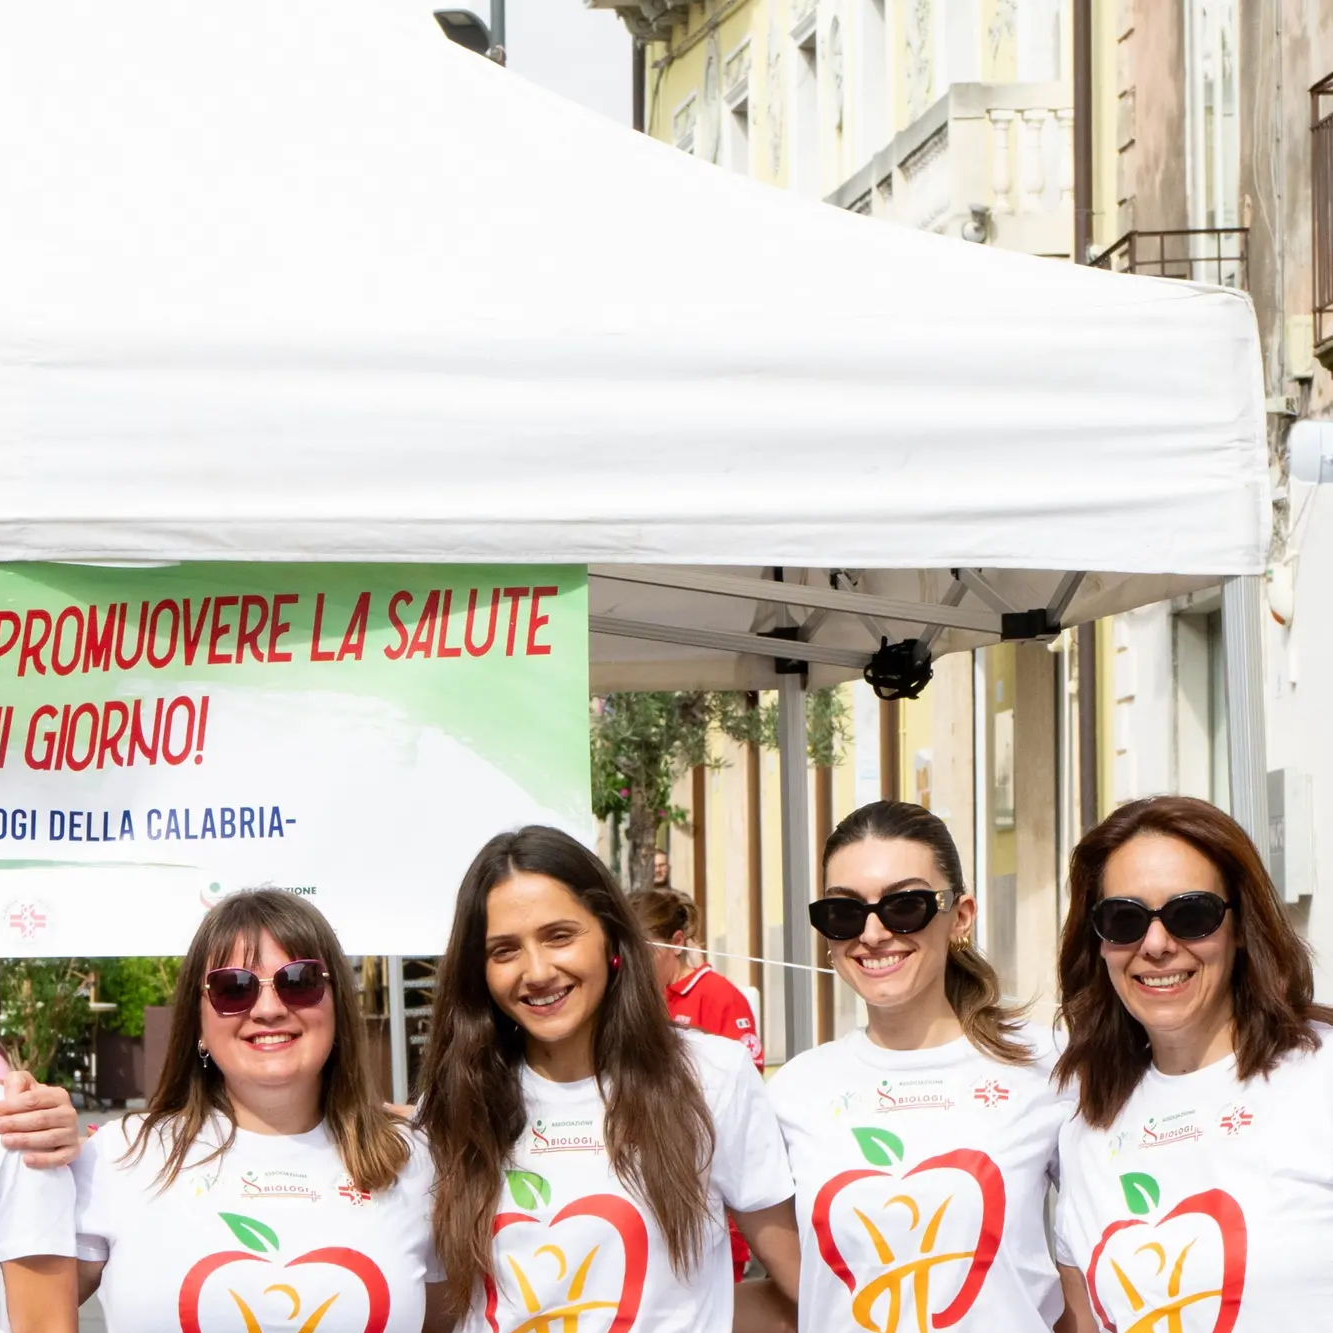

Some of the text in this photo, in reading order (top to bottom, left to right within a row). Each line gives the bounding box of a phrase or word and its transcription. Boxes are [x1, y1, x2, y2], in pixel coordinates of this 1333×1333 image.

[310, 591, 371, 662] LA
[383, 585, 558, 660] SALUTE
[24, 695, 209, 771] GIORNO!
[49, 809, 135, 842] DELLA
[147, 806, 296, 841] CALABRIA-
[898, 1095, 943, 1104] BIOLOGI
[1159, 1124, 1194, 1140] BIOLOGI
[551, 1136, 592, 1145] BIOLOGI
[264, 1185, 309, 1193] BIOLOGI
